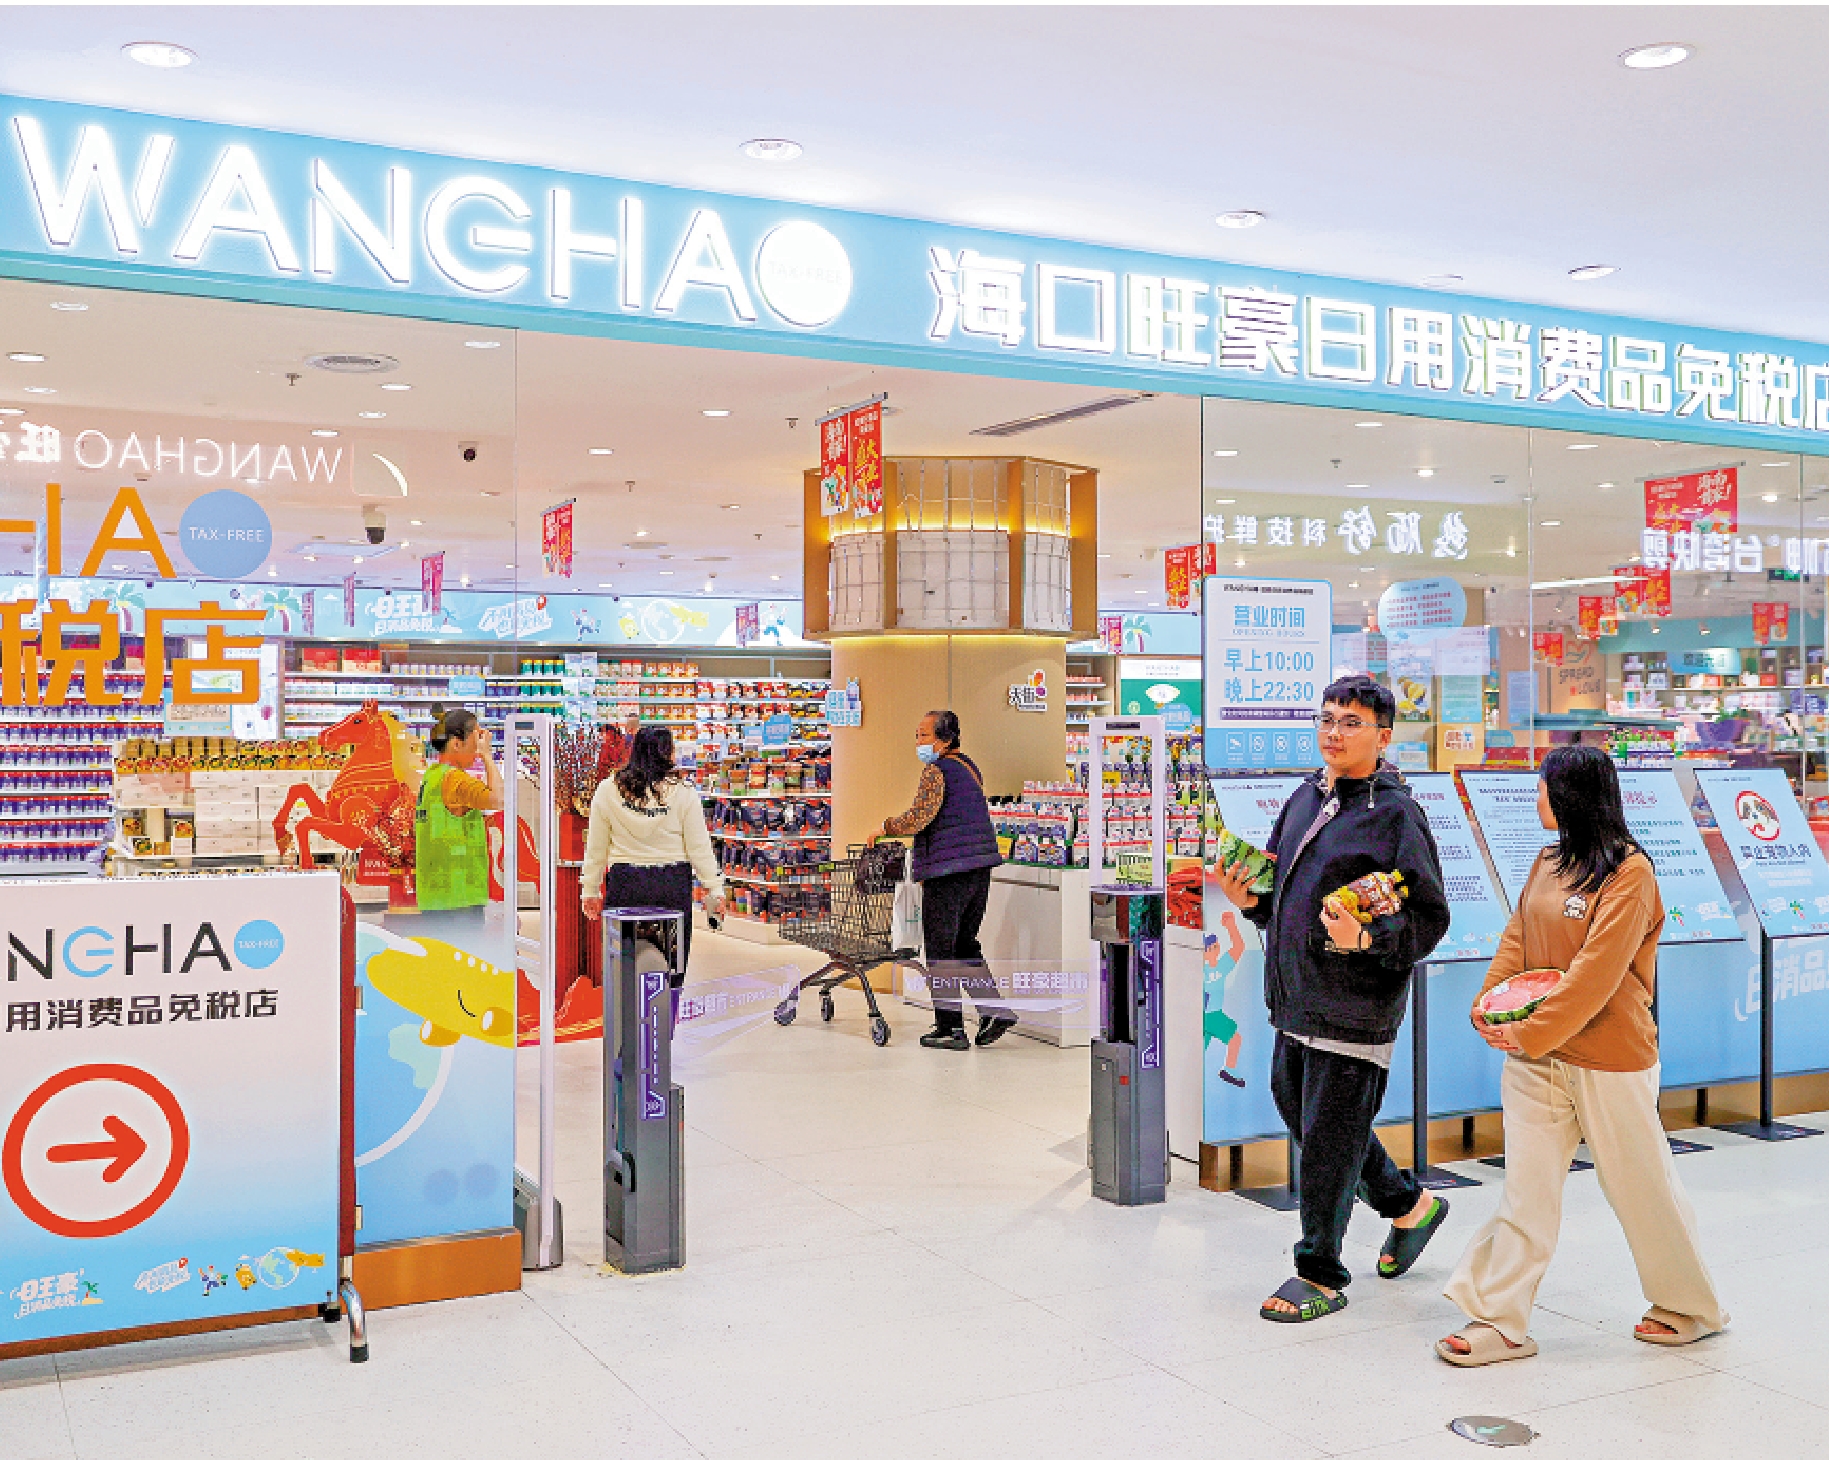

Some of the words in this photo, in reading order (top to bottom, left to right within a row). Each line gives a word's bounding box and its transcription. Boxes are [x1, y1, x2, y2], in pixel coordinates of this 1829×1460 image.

[189, 526, 265, 543] TAX-FREE
[1234, 605, 1305, 628] 营业时间
[1224, 648, 1314, 673] 早上10:00
[1224, 677, 1314, 703] 晚上22:30
[933, 976, 1010, 990] ENTRANCE
[5, 988, 279, 1033] 用消费品免税店
